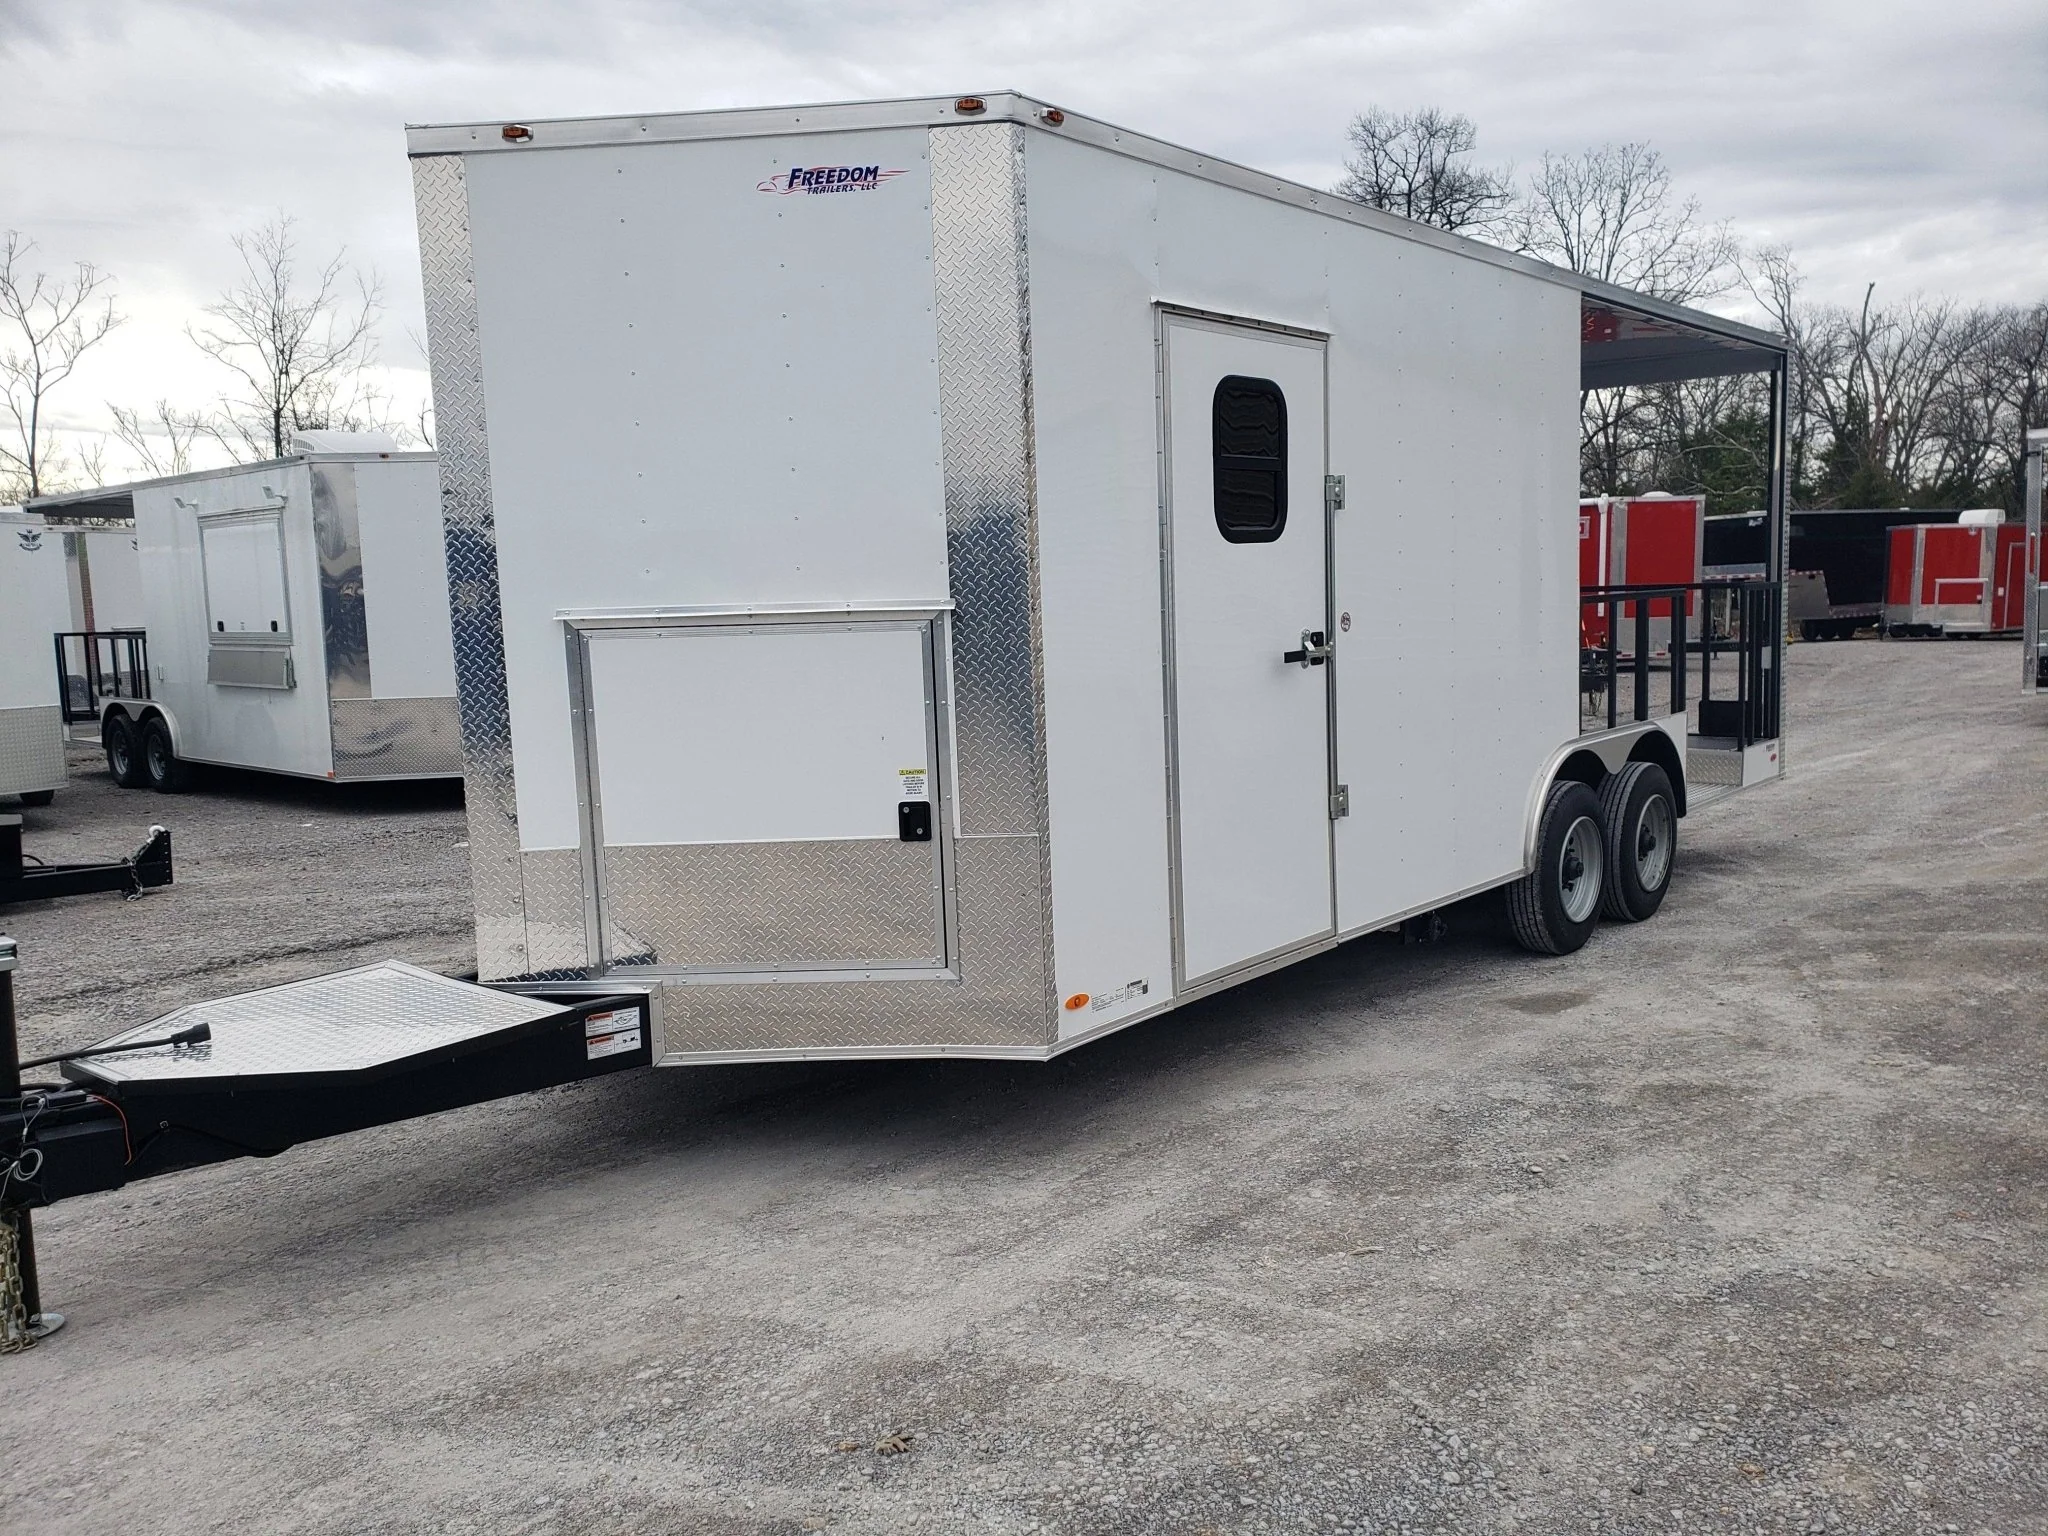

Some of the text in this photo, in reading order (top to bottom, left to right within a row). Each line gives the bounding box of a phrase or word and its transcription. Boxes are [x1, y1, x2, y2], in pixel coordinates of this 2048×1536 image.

[788, 166, 879, 189] FREEDOM
[807, 182, 879, 195] TRAILERS, LLC
